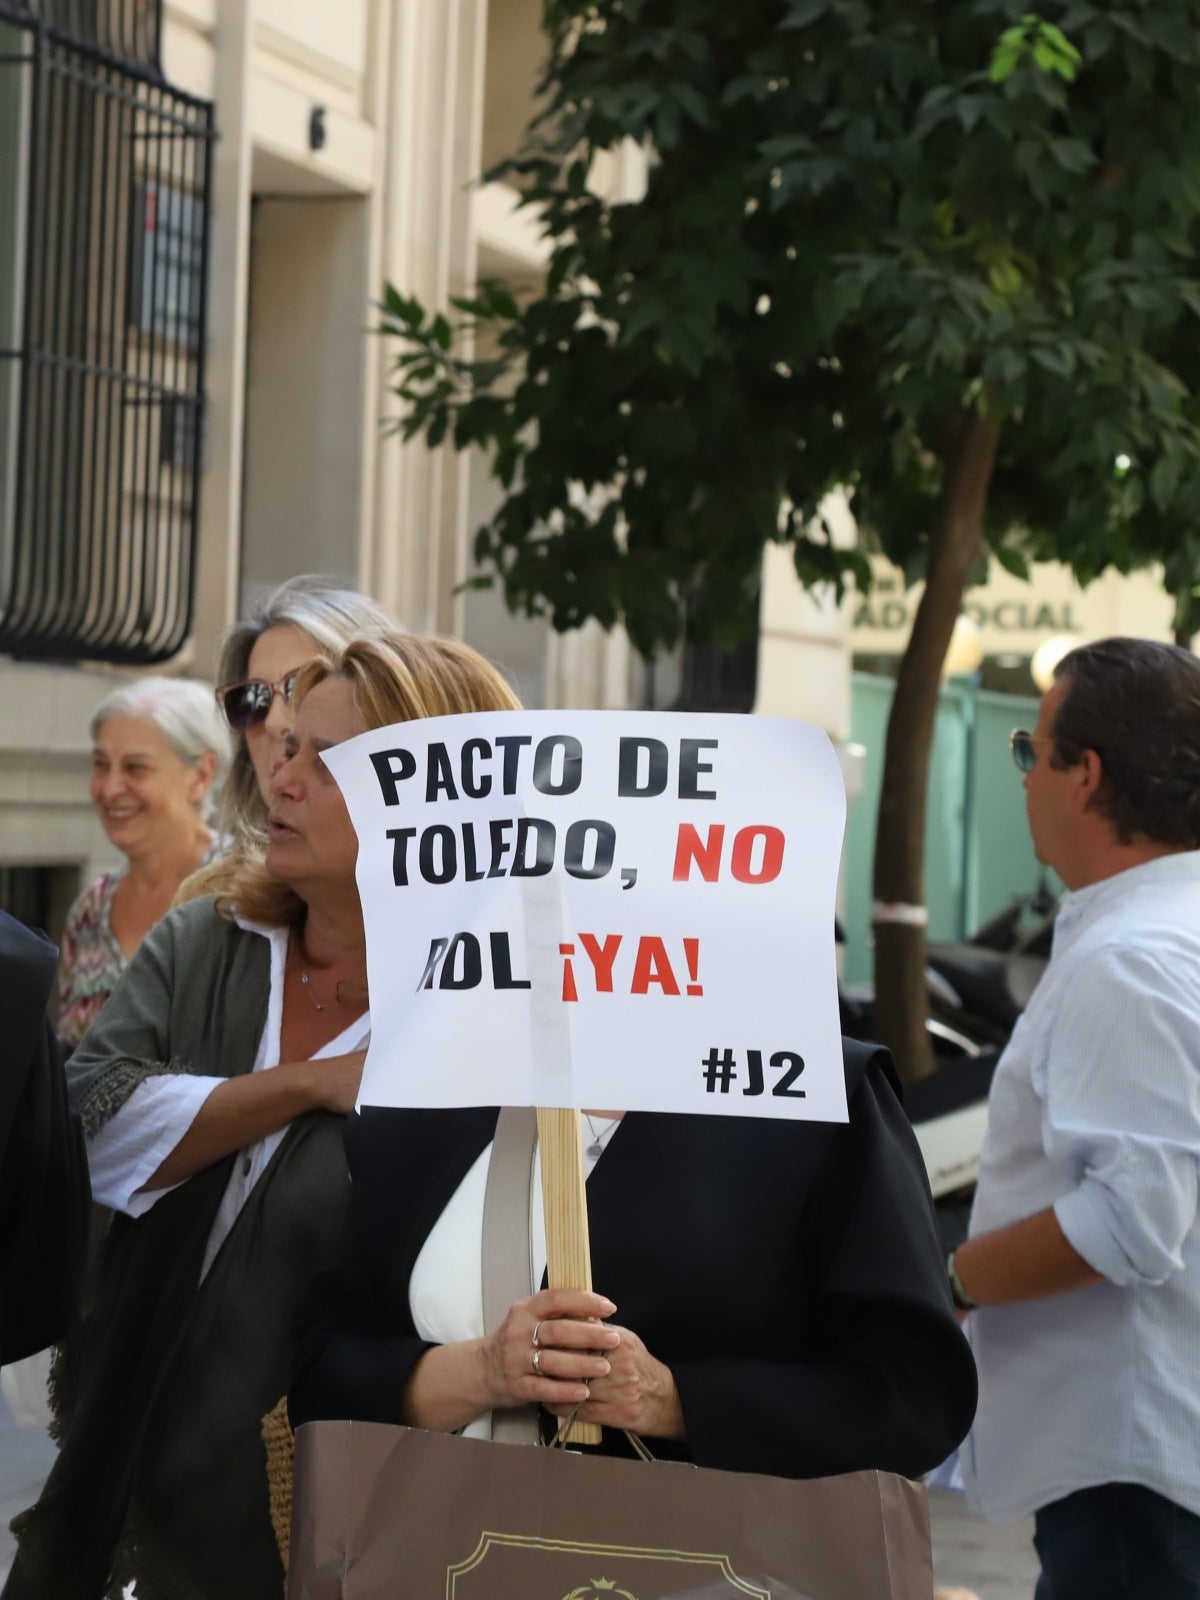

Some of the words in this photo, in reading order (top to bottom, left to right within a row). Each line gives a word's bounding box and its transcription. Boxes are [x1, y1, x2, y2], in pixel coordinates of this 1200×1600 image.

[309, 106, 325, 150] 6
[962, 603, 1081, 630] OCIAL
[369, 735, 583, 806] PACTO
[617, 737, 719, 800] DE
[386, 818, 638, 890] TOLEDO,
[672, 823, 785, 884] NO
[559, 932, 704, 1002] ¡YA!
[701, 1048, 807, 1098] #J2
